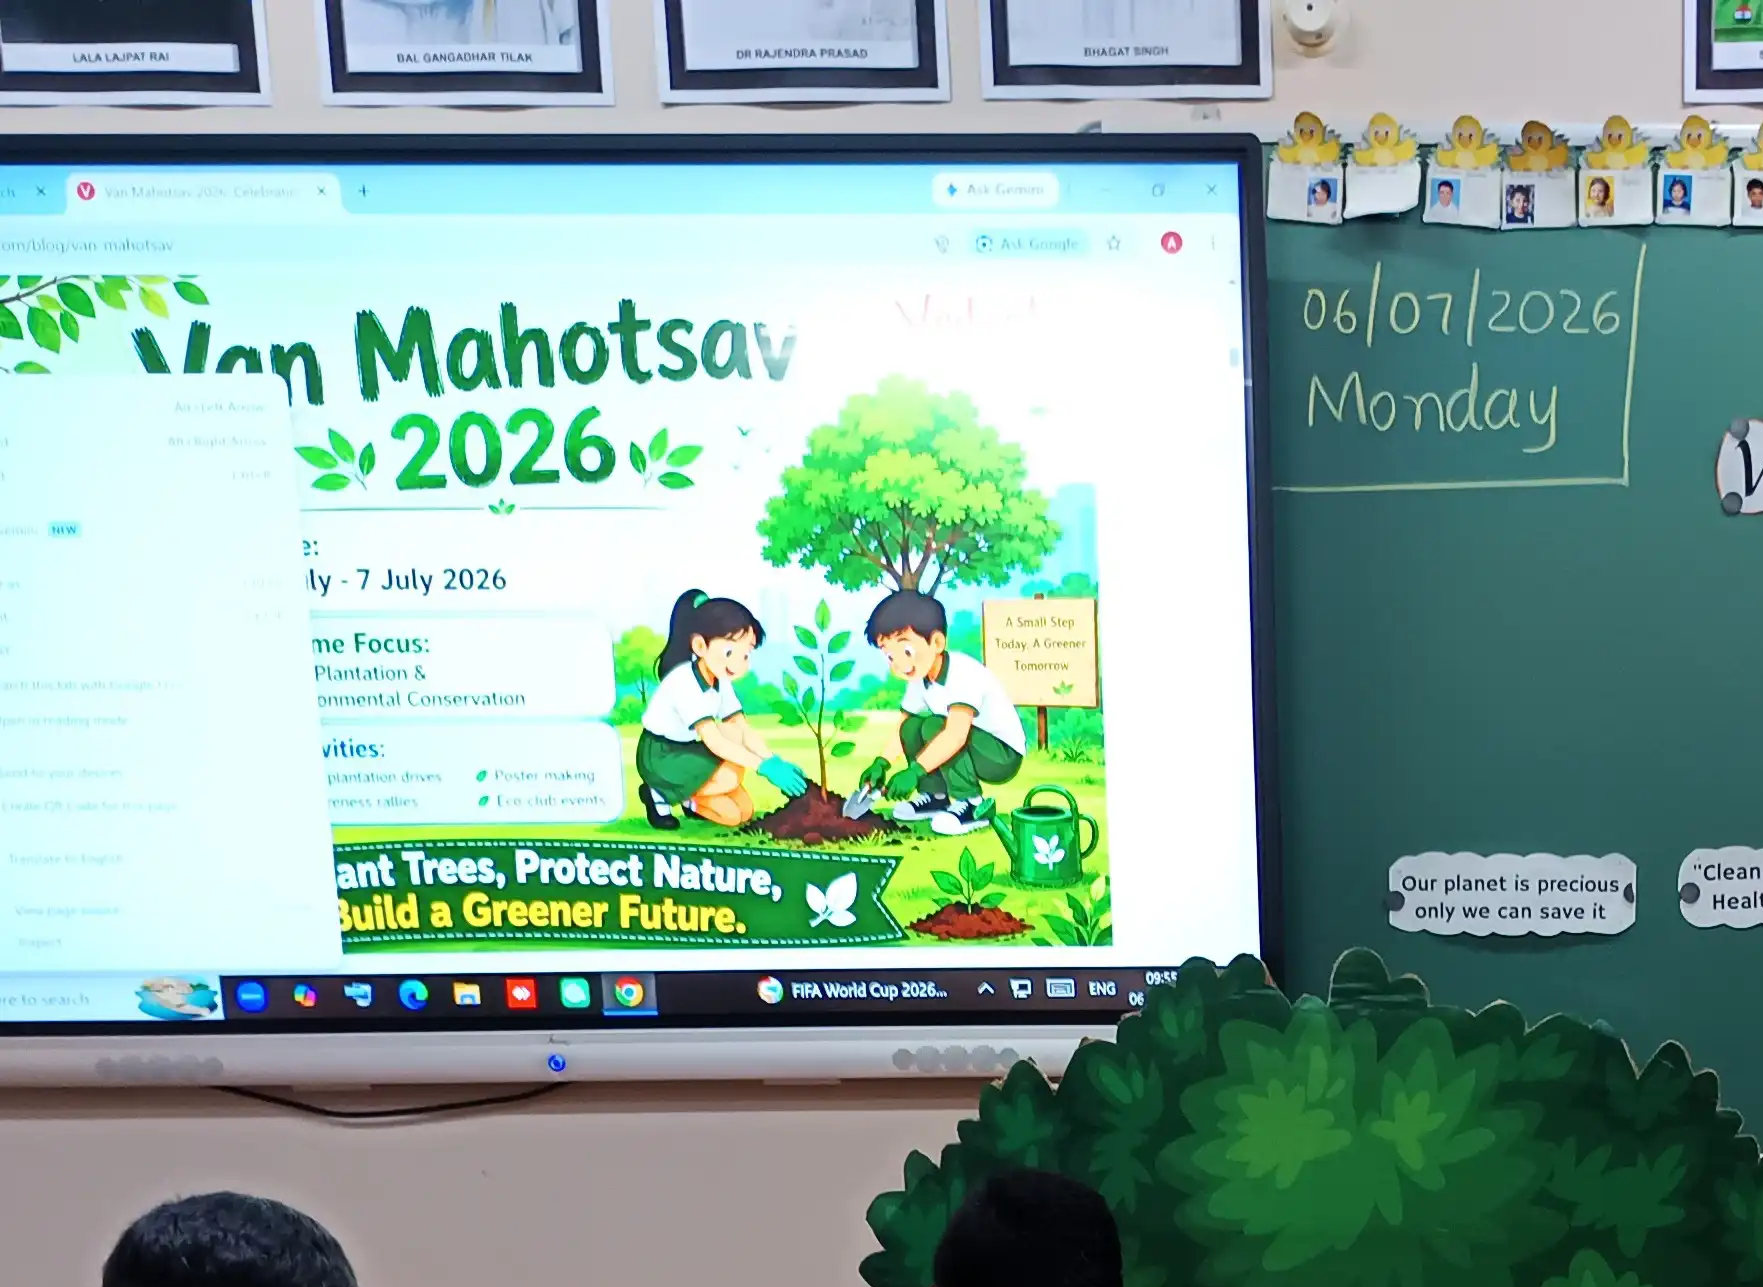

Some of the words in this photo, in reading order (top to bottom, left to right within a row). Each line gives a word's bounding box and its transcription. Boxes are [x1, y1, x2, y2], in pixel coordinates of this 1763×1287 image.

[72, 51, 103, 63] LALA
[105, 51, 146, 63] LAJPAT
[149, 51, 170, 62] RAI
[423, 51, 497, 63] GANGADHAR
[500, 52, 534, 63] TILAK
[736, 49, 752, 60] DR
[754, 48, 817, 60] RAJENDRA
[820, 48, 869, 60] PRASAD
[1083, 46, 1131, 58] BHAGAT
[1133, 45, 1170, 57] SINGH
[1302, 259, 1621, 348] 06/07/2026
[354, 298, 798, 403] Mahotsav
[1307, 361, 1558, 454] Monday
[391, 405, 617, 492] 2026
[305, 567, 332, 597] ly
[356, 568, 371, 591] 7
[380, 567, 433, 597] July
[442, 567, 508, 591] 2026
[1016, 615, 1048, 629] Small
[1050, 615, 1075, 631] Step
[311, 637, 346, 654] me
[353, 632, 431, 654] Focus:
[1043, 637, 1087, 650] Greener
[314, 663, 409, 683] Plantation
[413, 664, 427, 682] &
[1013, 659, 1070, 672] Tomorrow
[317, 689, 402, 708] onmental
[406, 690, 527, 707] Conservation
[322, 737, 386, 758] vities:
[543, 769, 596, 786] making
[327, 795, 374, 809] reness
[336, 852, 396, 890] ant
[400, 849, 507, 890] Trees,
[514, 848, 644, 888] Protect
[652, 852, 783, 903] Nature,
[1692, 862, 1762, 882] "Clean
[1401, 874, 1439, 893] Our
[1443, 873, 1508, 898] planet
[1514, 873, 1530, 893] is
[1537, 873, 1620, 898] precious
[338, 892, 419, 933] Build
[429, 902, 453, 928] a
[462, 892, 609, 929] Greener
[618, 893, 748, 935] Future.
[1414, 901, 1457, 924] only
[1461, 905, 1492, 921] we
[1496, 905, 1533, 921] can
[1538, 905, 1586, 921] save
[1591, 901, 1608, 920] it
[791, 981, 823, 1000] FIFA
[825, 980, 866, 1000] World
[868, 981, 899, 1002] Cup
[900, 981, 948, 1000] 2026...
[1088, 980, 1118, 998] ENG
[1127, 990, 1147, 1007] 06
